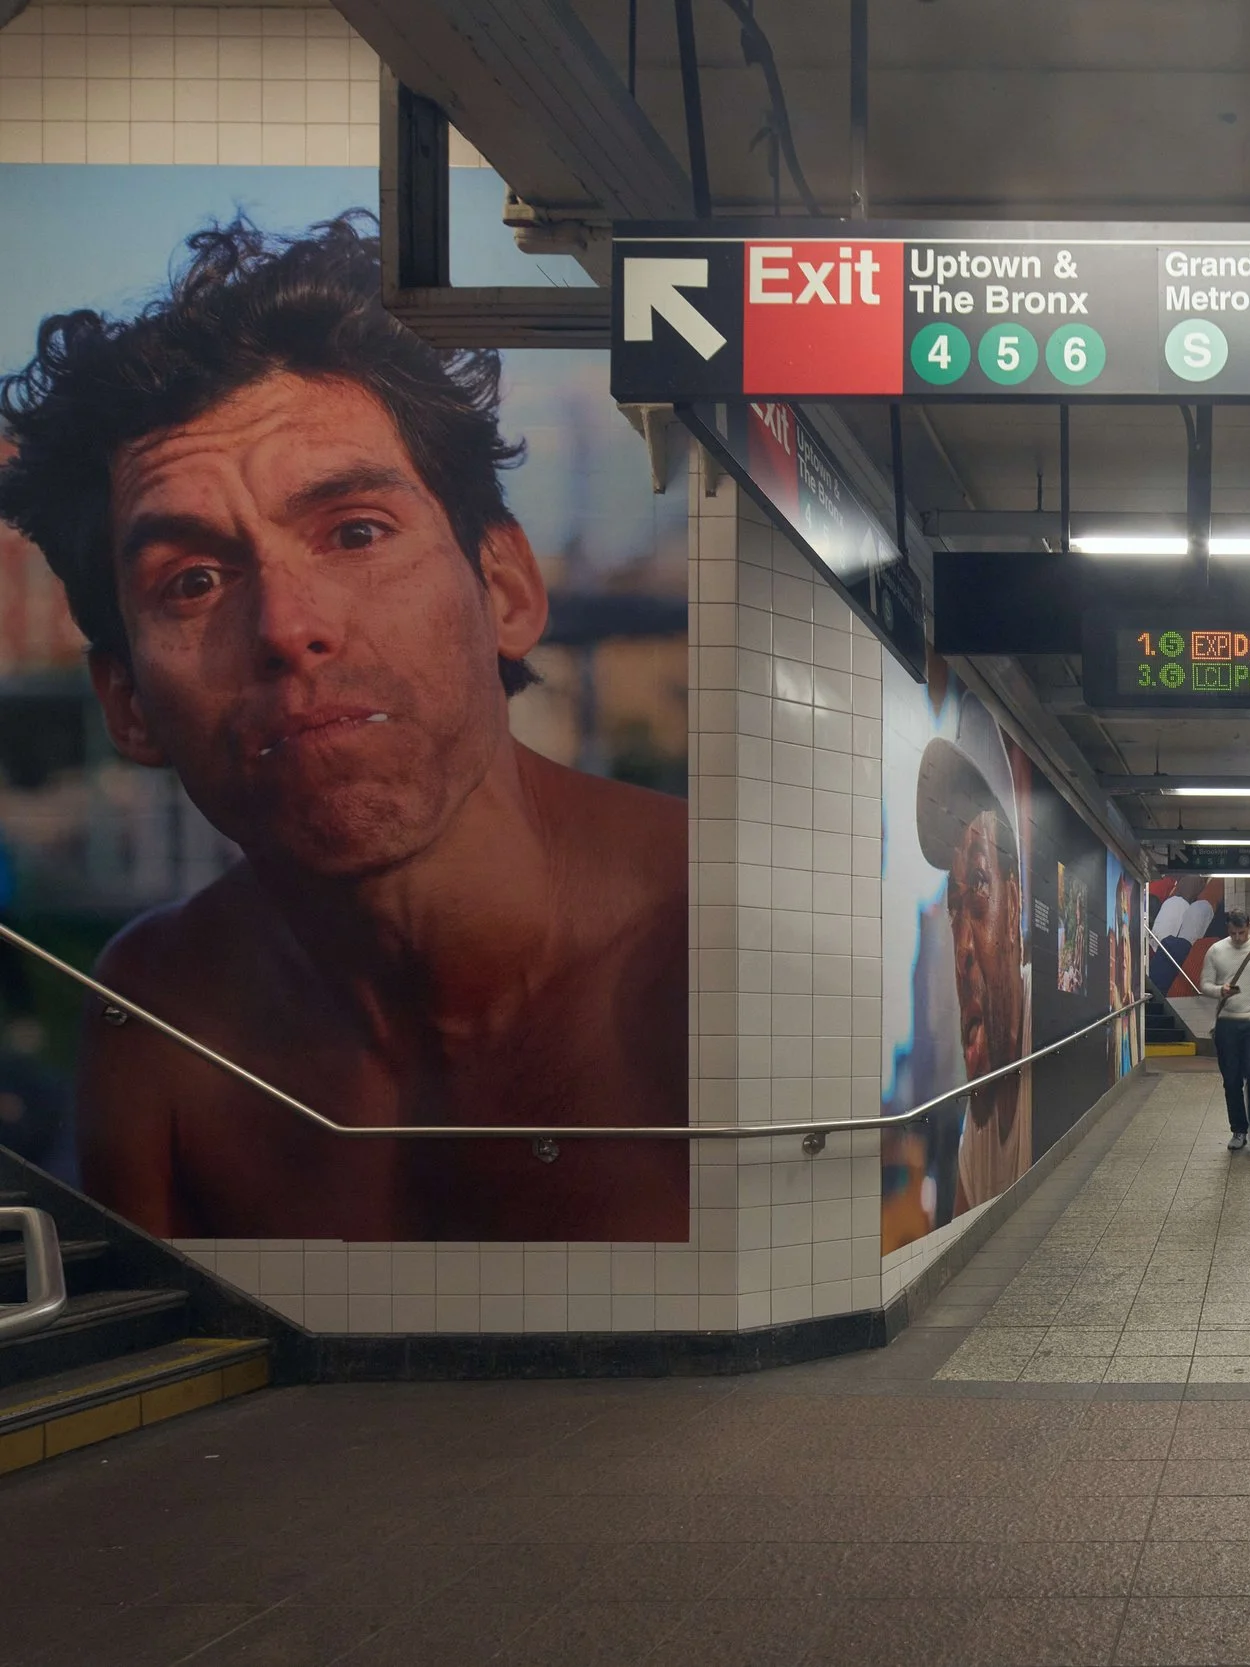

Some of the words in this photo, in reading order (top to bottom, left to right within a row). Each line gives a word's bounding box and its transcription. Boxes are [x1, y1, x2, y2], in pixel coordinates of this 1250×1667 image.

[748, 246, 880, 305] Exit
[909, 249, 1041, 285] Uptown
[1053, 249, 1078, 279] &
[909, 283, 974, 314] The
[986, 285, 1089, 314] Bronx
[797, 425, 832, 490] Uptown
[797, 452, 816, 494] The
[1137, 632, 1156, 656] 1.
[1195, 635, 1228, 656] EXP
[1138, 664, 1156, 686] 3.
[1196, 667, 1228, 687] LCL
